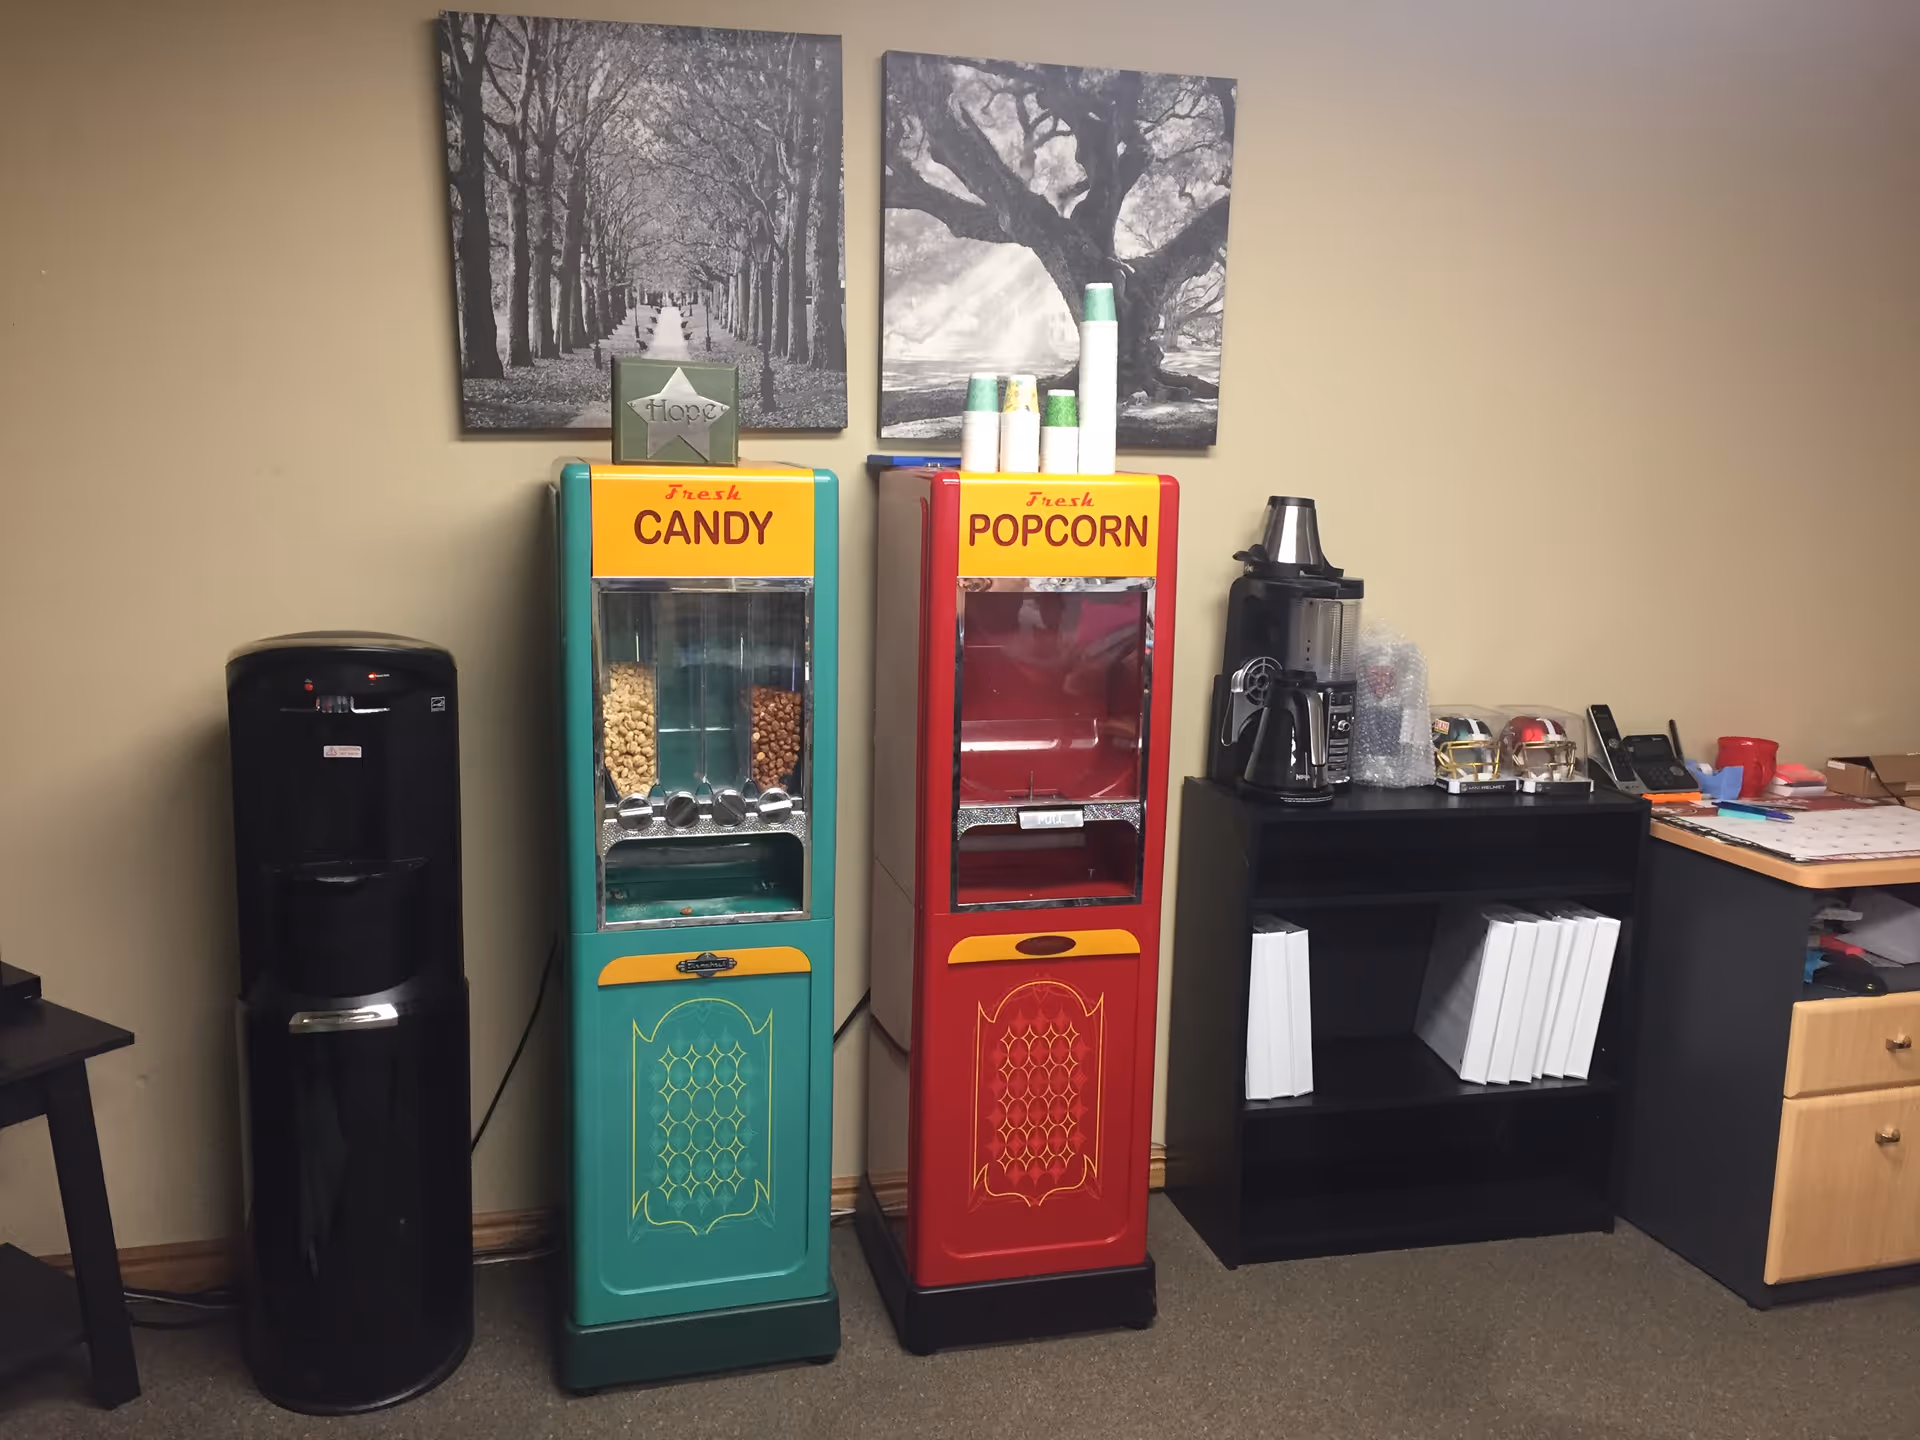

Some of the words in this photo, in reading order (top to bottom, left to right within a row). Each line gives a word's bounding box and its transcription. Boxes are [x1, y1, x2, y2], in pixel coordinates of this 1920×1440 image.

[645, 399, 717, 426] Hope
[665, 484, 742, 501] Fresh
[1026, 491, 1095, 507] Fresh
[633, 509, 774, 545] CANDY
[968, 513, 1149, 548] POPCORN
